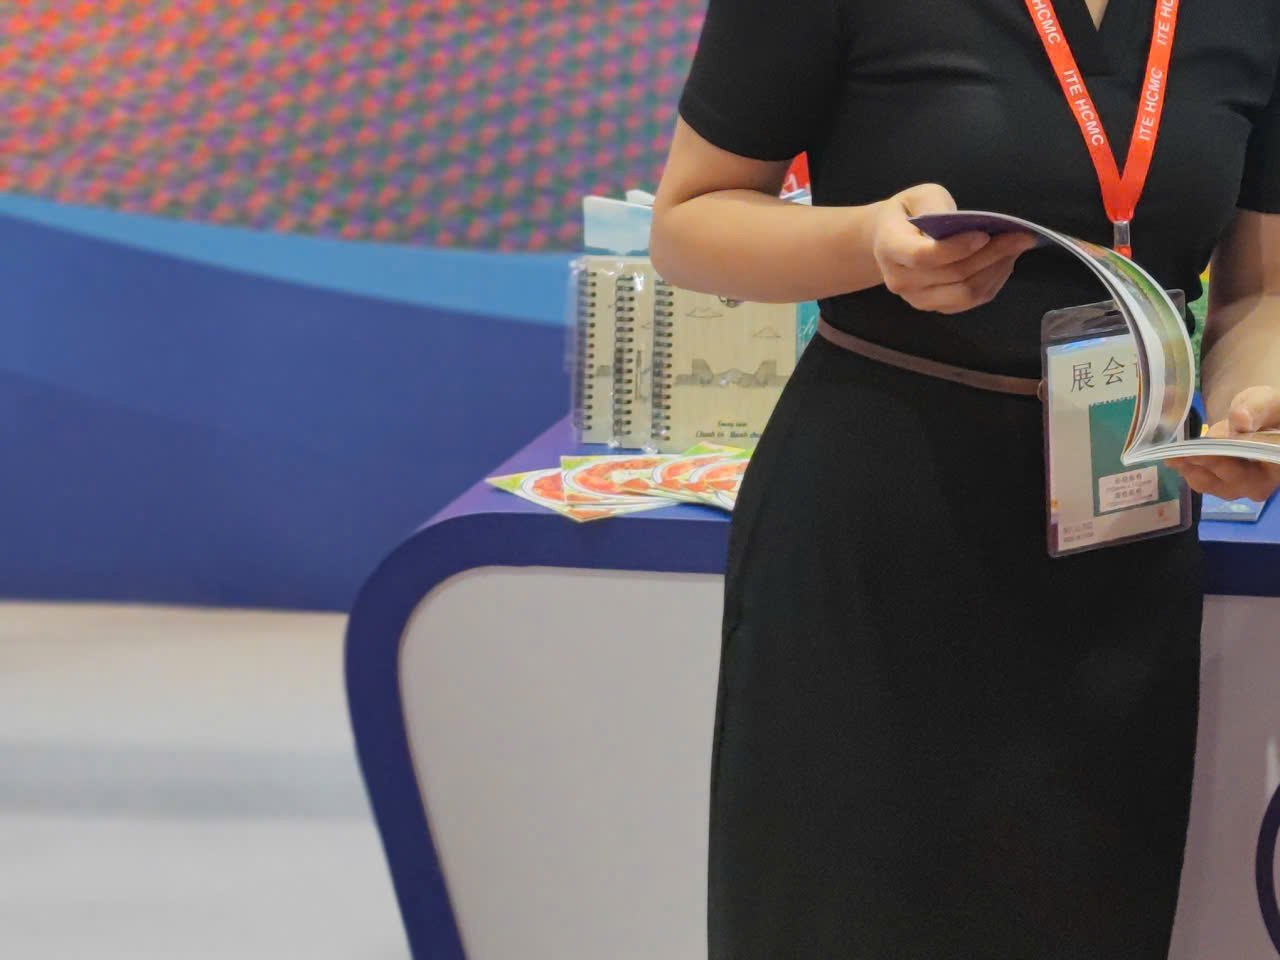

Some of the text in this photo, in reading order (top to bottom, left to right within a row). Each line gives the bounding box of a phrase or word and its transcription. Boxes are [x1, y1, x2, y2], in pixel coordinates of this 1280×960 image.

[1157, 19, 1171, 46] ITE
[1063, 68, 1105, 146] ITE HCMC
[1138, 67, 1163, 142] ITE HCMC
[1070, 354, 1139, 393] 展会
